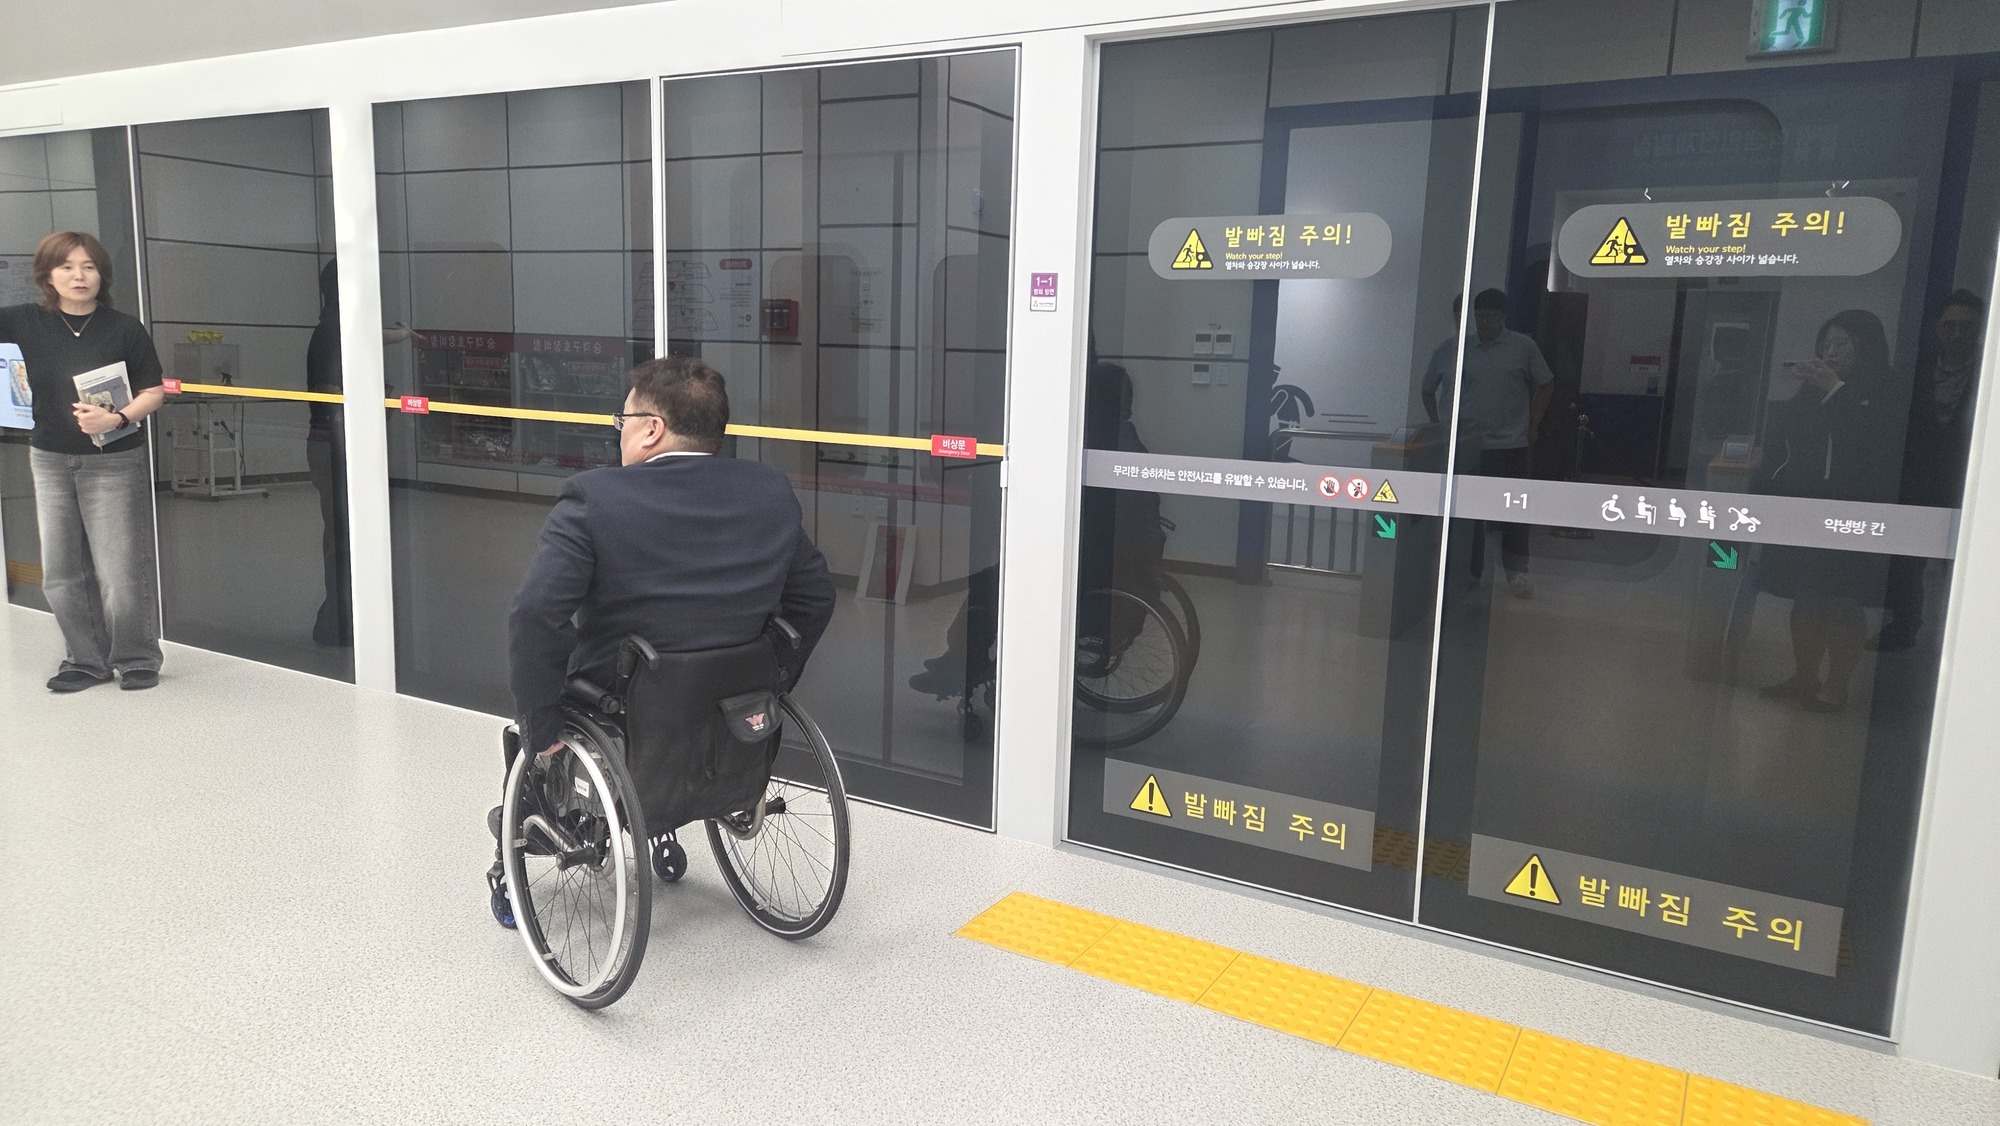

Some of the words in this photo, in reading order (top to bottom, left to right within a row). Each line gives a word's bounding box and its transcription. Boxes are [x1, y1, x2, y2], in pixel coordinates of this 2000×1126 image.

[1666, 212, 1751, 239] 발빠짐
[1771, 210, 1845, 236] 주의!
[1225, 225, 1286, 248] 발빠짐
[1299, 223, 1353, 246] 주의!
[1225, 252, 1247, 260] Watch
[1248, 253, 1264, 261] your
[1265, 251, 1283, 260] step!
[1666, 245, 1695, 254] Watch
[1698, 246, 1720, 255] your
[1722, 244, 1747, 254] step!
[1225, 260, 1246, 270] 열차와
[1246, 260, 1268, 270] 승강장
[1269, 260, 1290, 269] 사이가
[1291, 260, 1321, 270] 넓습니다.
[1664, 255, 1693, 266] 열차와
[1694, 254, 1724, 266] 승강장
[1726, 254, 1756, 265] 사이가
[1758, 253, 1799, 265] 넓습니다.
[1036, 276, 1053, 287] 1-1
[1044, 288, 1055, 296] 방면
[942, 439, 966, 451] 비상문
[1113, 465, 1140, 478] 무리한
[1140, 467, 1176, 482] 승하차는
[1177, 470, 1223, 485] 안전사고를
[1224, 474, 1253, 487] 유발할
[1255, 475, 1265, 488] 수
[1267, 477, 1309, 491] 있습니다.
[1503, 492, 1528, 510] 1-1
[1824, 518, 1868, 535] 약냉방
[1870, 522, 1886, 536] 칸
[1183, 791, 1267, 833] 발빠짐
[1288, 813, 1346, 851] 주의
[1578, 875, 1691, 927] 발빠짐
[1722, 906, 1804, 952] 주의
